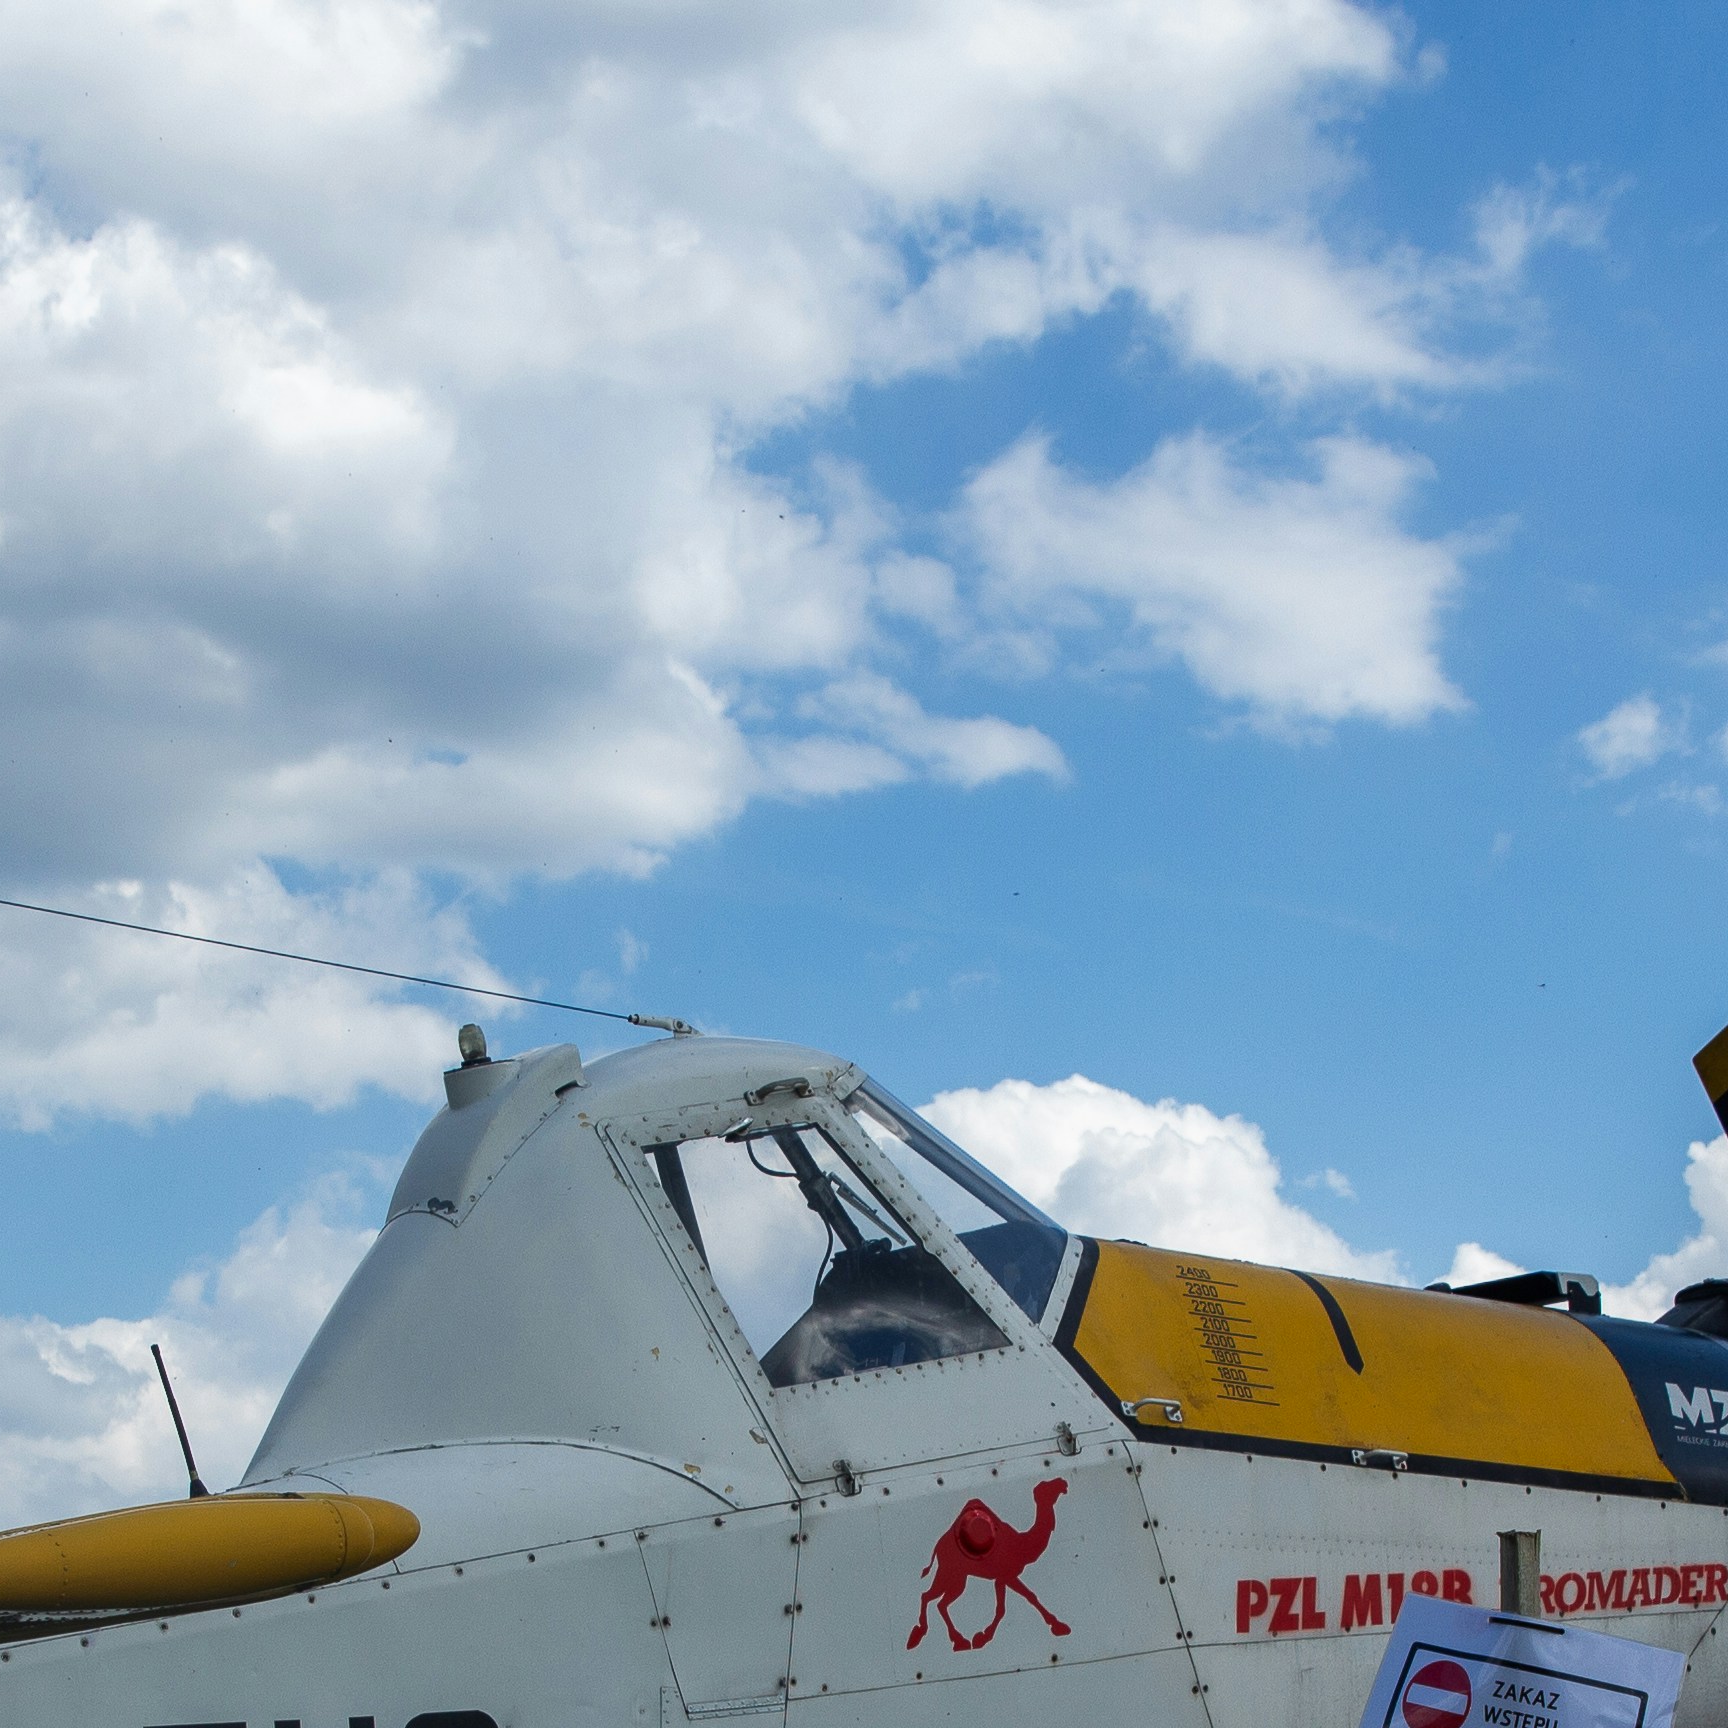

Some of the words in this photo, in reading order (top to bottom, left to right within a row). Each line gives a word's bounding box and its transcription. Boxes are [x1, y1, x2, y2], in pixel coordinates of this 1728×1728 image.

[1176, 1265, 1211, 1279] 2400
[1185, 1282, 1218, 1297] 2300
[1191, 1300, 1224, 1315] 2200
[1200, 1316, 1230, 1331] 2100
[1203, 1333, 1236, 1348] 2000
[1212, 1349, 1242, 1365] 1900
[1217, 1366, 1247, 1382] 1800
[1223, 1383, 1253, 1398] 1700
[1236, 1576, 1326, 1633] PZL
[1493, 1680, 1560, 1710] ZAKAZ
